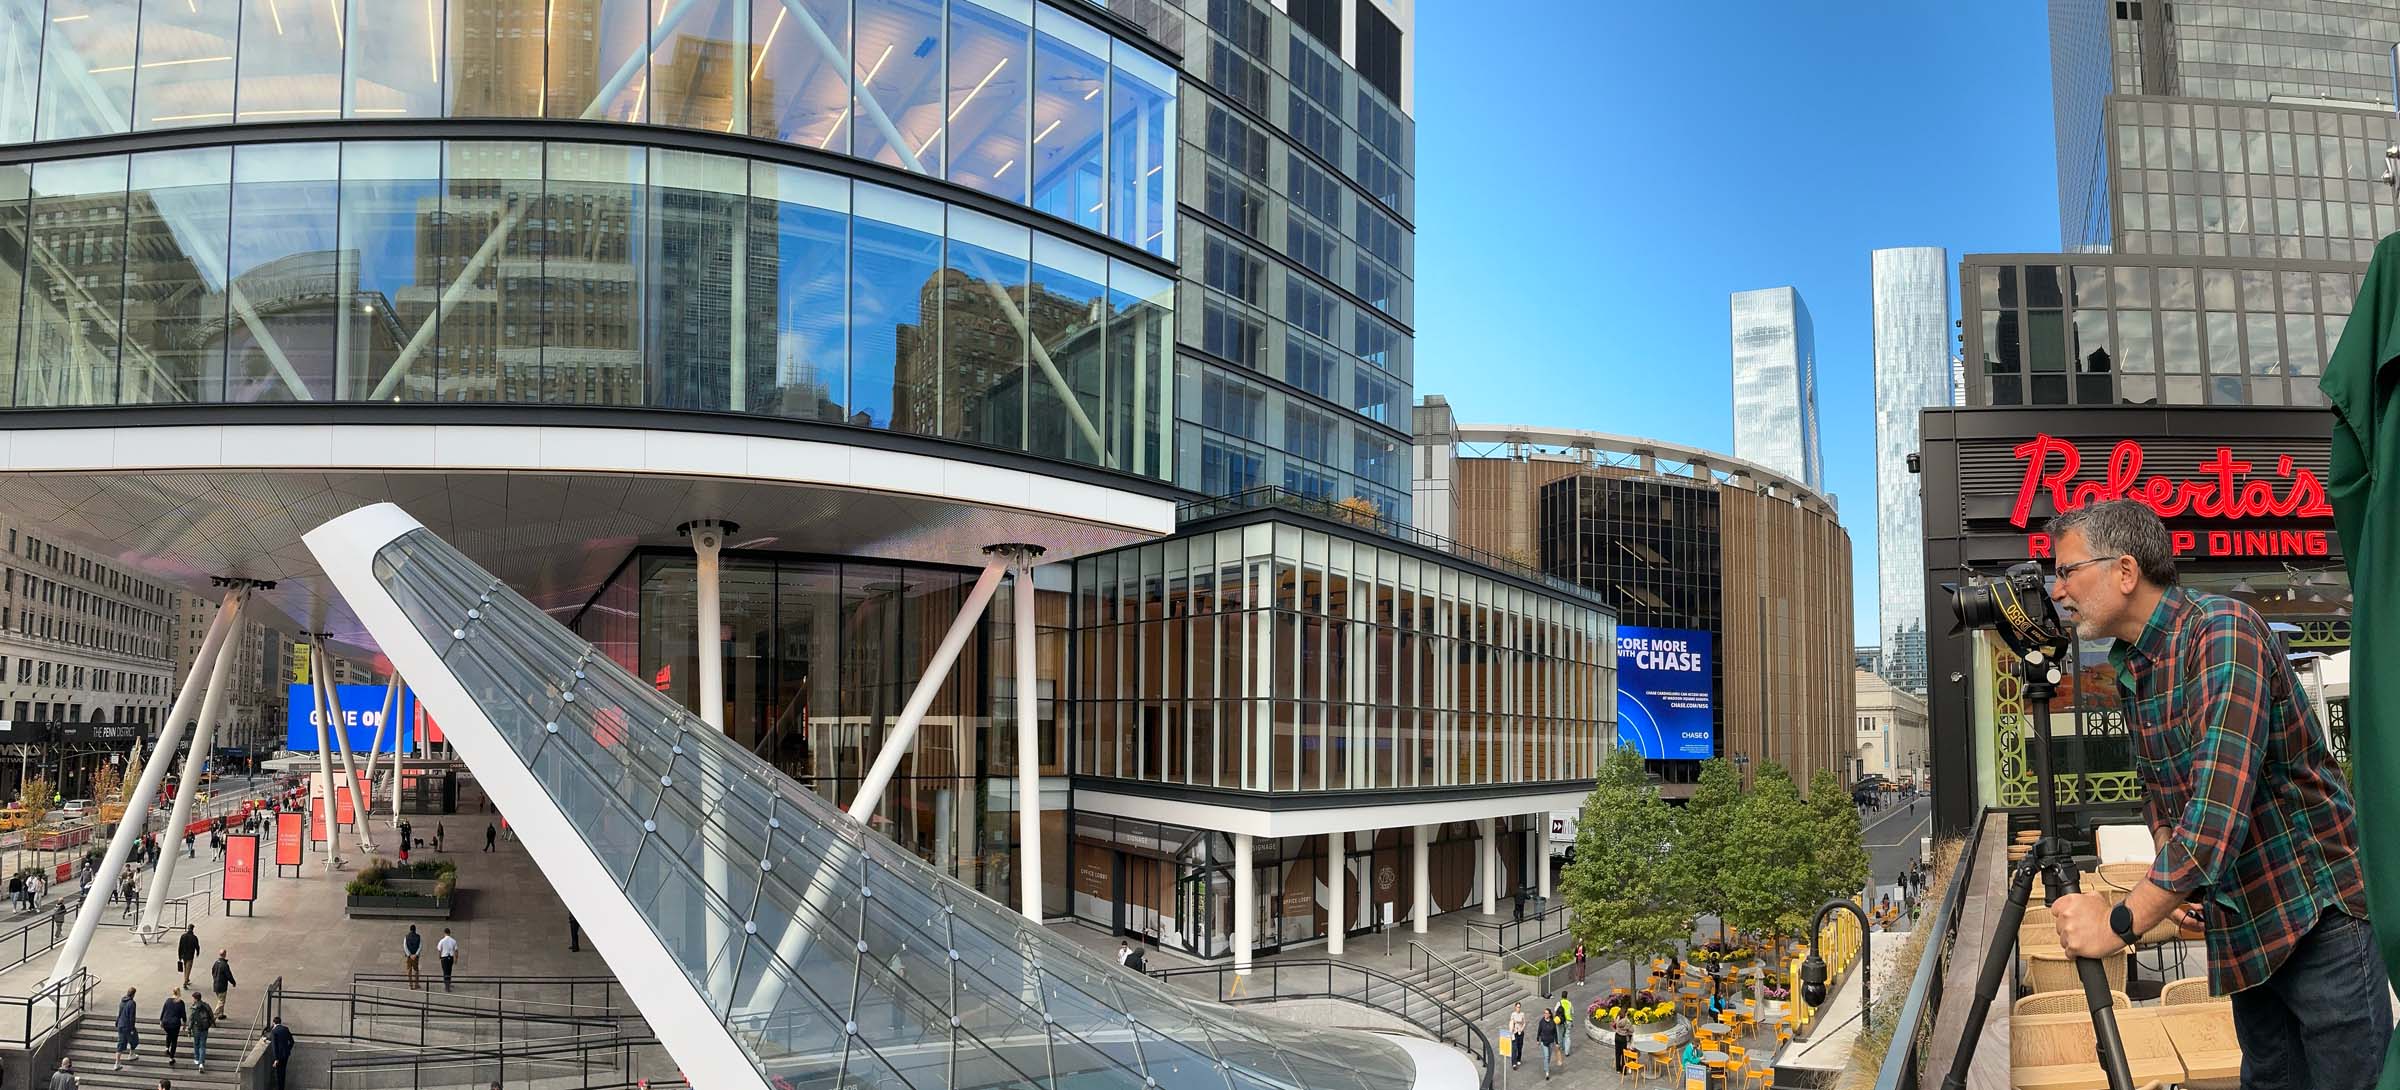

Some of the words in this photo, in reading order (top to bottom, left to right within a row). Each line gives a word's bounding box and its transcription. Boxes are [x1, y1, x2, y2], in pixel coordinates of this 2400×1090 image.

[2010, 431, 2334, 528] Roberta's
[2209, 530, 2328, 556] DINING
[2006, 603, 2033, 633] D850
[1651, 639, 1688, 653] MORE
[1636, 651, 1701, 671] CHASE
[93, 726, 102, 738] THE
[103, 726, 117, 738] PENN
[117, 726, 135, 737] DISTRICT
[1681, 731, 1703, 739] CHASE
